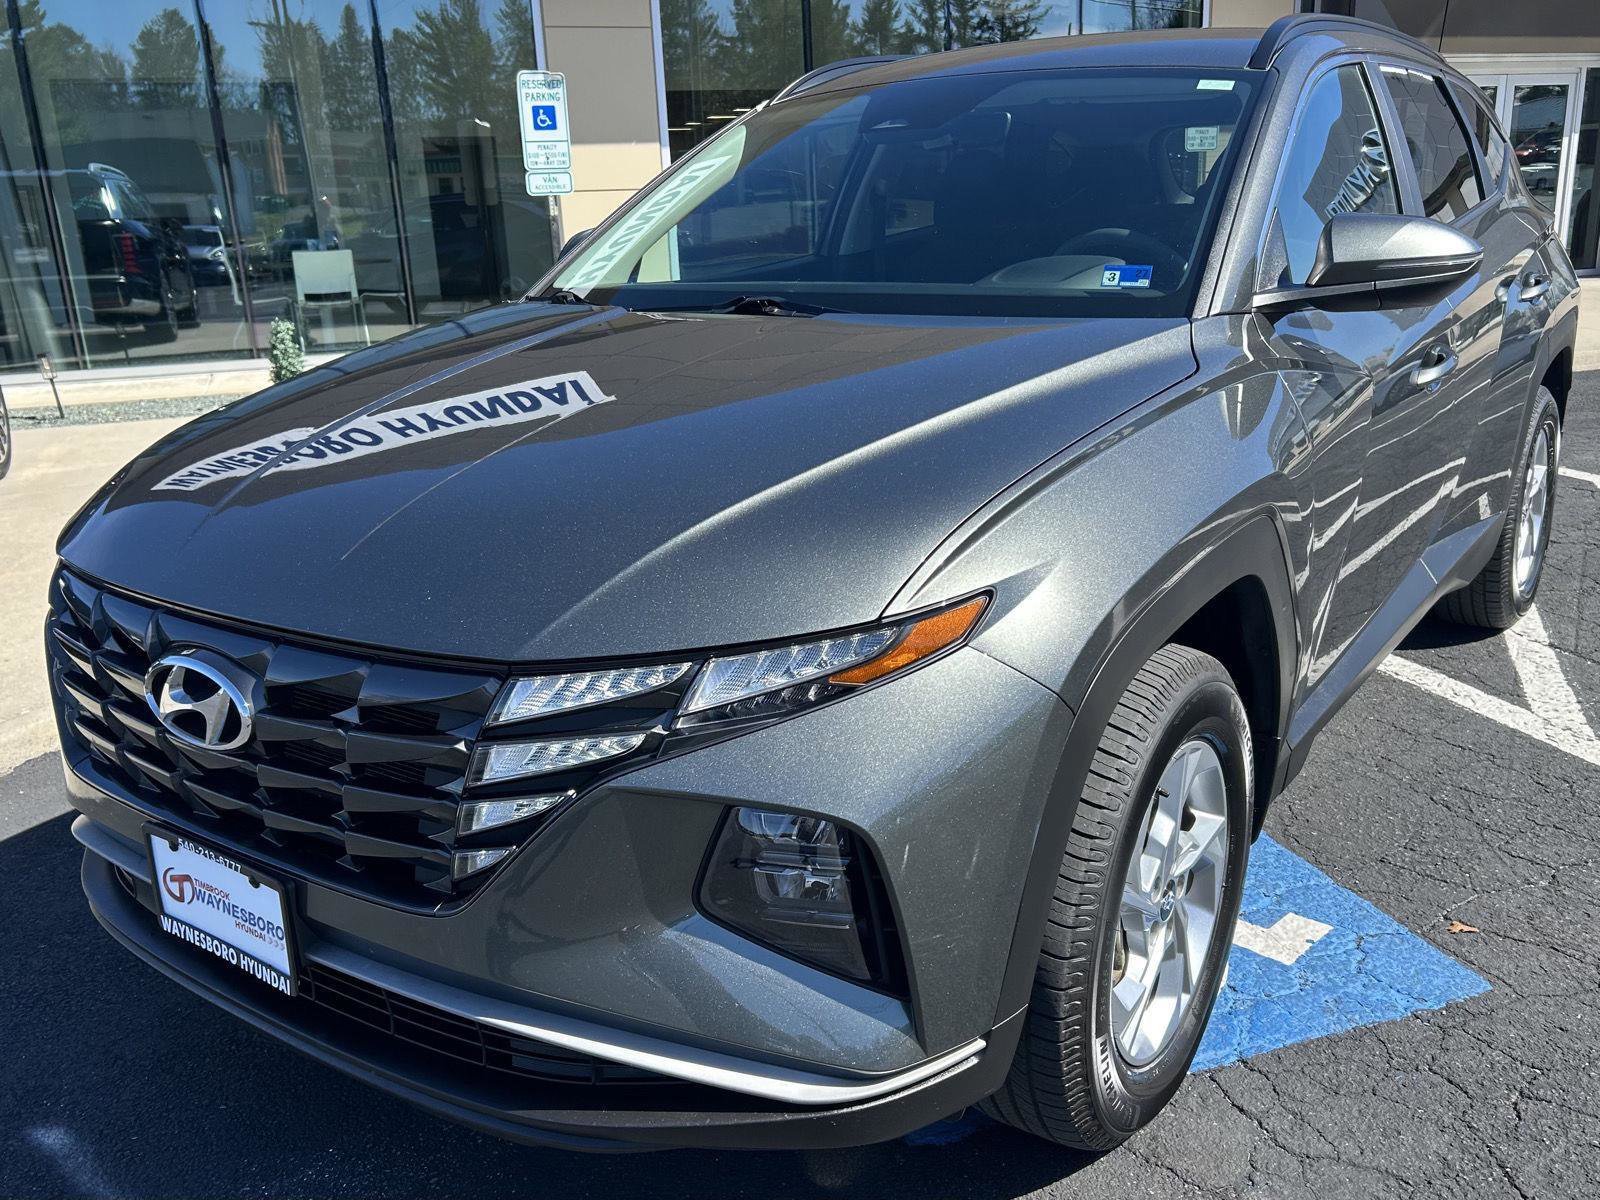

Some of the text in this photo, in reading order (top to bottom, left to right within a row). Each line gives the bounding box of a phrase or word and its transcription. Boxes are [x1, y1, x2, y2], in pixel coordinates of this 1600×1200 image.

[521, 79, 563, 89] RESERVED
[525, 92, 560, 102] PARKING
[1107, 272, 1117, 282] 3
[194, 877, 230, 900] TIMBROOK
[194, 887, 285, 941] WAYNESBORO
[235, 920, 266, 943] HYUNDAI
[160, 914, 291, 996] WAYNESBORO HYUNDAI
